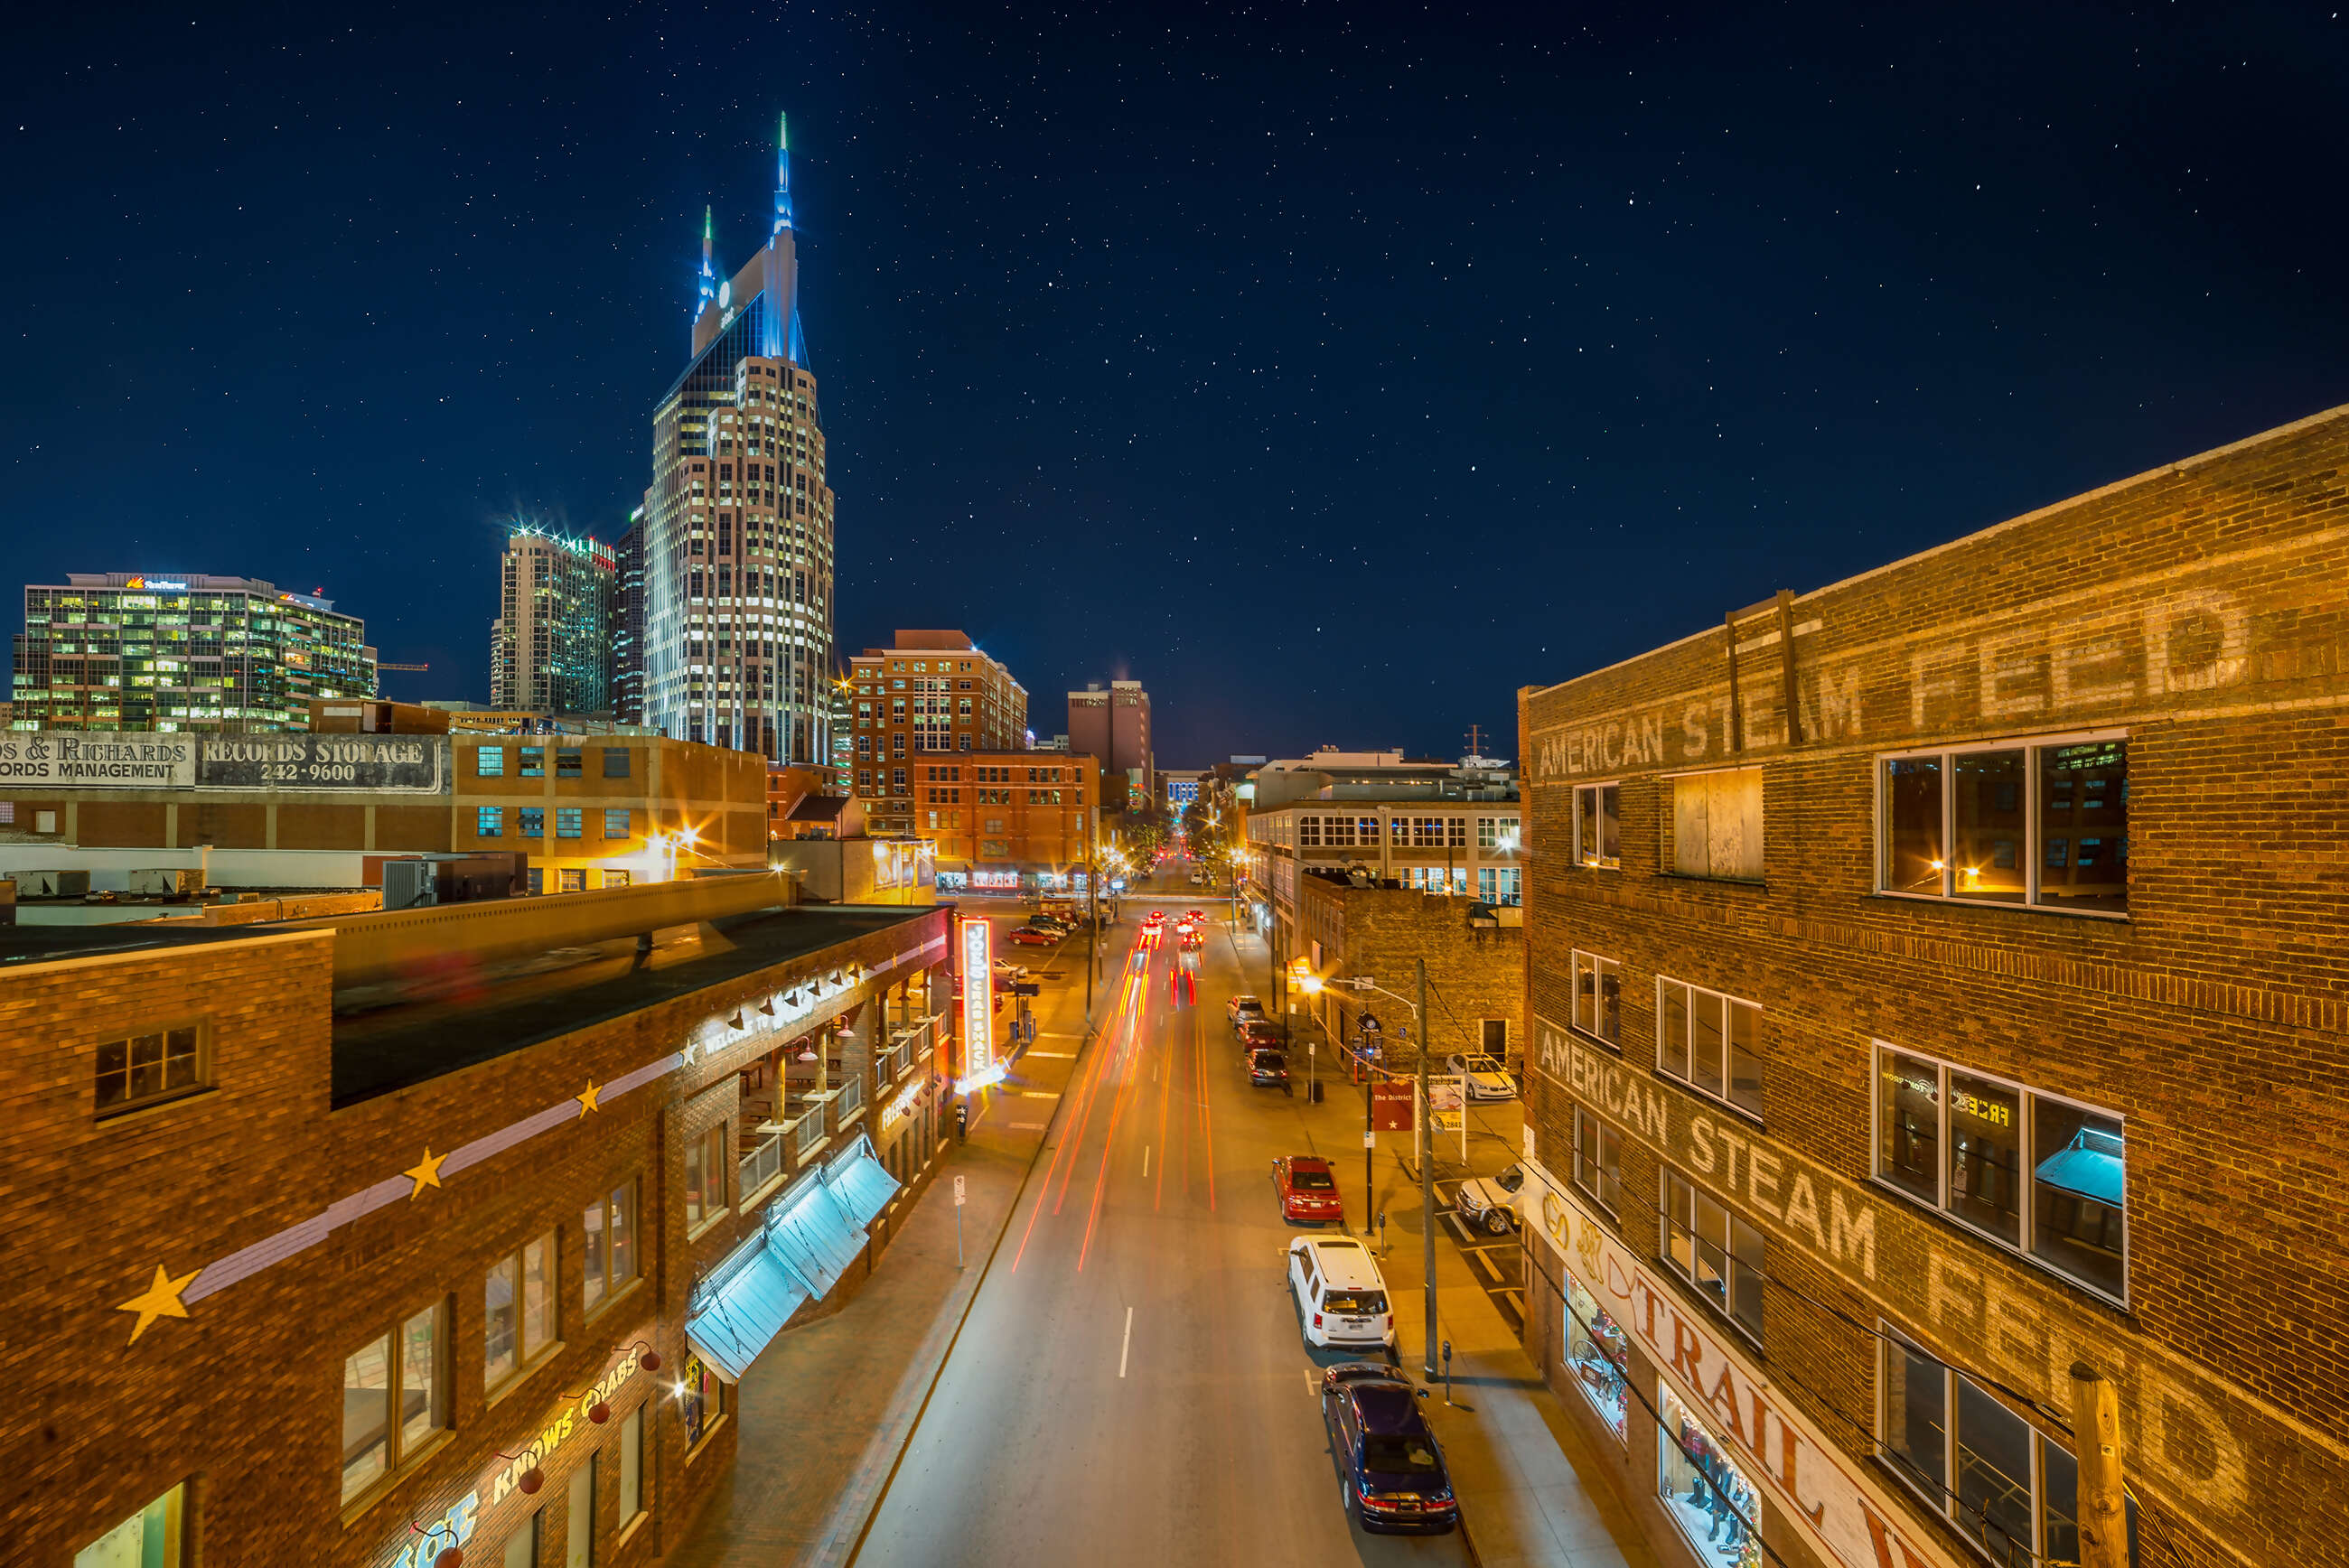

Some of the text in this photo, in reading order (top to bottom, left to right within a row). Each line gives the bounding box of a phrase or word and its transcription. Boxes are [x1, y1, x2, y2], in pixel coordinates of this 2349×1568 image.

[1911, 588, 2251, 729] FEED
[0, 736, 186, 762] S & RICHARDS
[59, 762, 174, 779] MANAGEMENT
[202, 741, 423, 764] RECORDS STORAGE
[1539, 710, 1664, 777] AMERICAN
[970, 980, 985, 1019] CRAB
[971, 1021, 987, 1072] SHACK
[1540, 1031, 1669, 1147] AMERICAN
[1689, 1116, 1876, 1282] STEAM
[493, 1406, 574, 1507] KNOWS
[581, 1347, 637, 1418] CRABS
[1635, 1275, 1824, 1529] TRAIL
